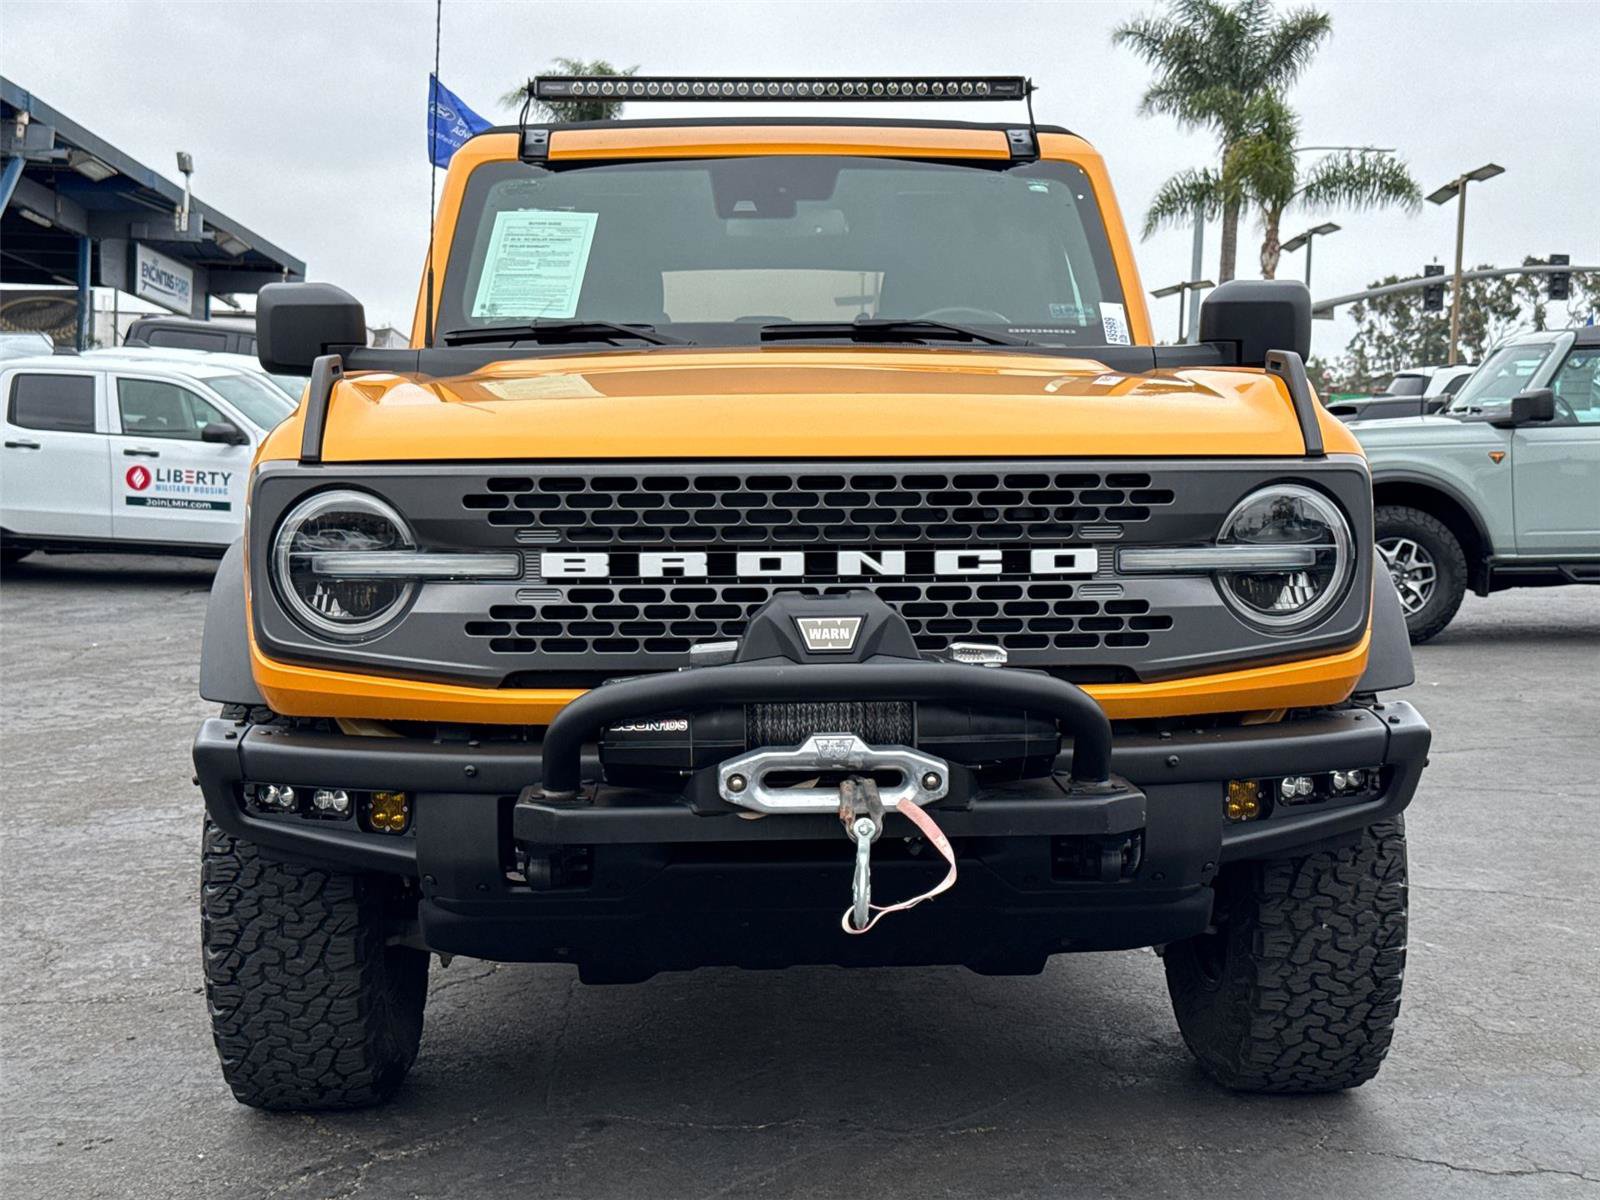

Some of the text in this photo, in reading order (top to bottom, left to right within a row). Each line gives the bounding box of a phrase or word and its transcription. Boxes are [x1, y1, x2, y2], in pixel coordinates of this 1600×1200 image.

[156, 468, 232, 486] LIBERTY
[156, 484, 229, 495] MILITARY HOUSING
[146, 498, 212, 510] JoinLMH.com
[541, 549, 1098, 577] BRONCO
[809, 627, 850, 640] WARN
